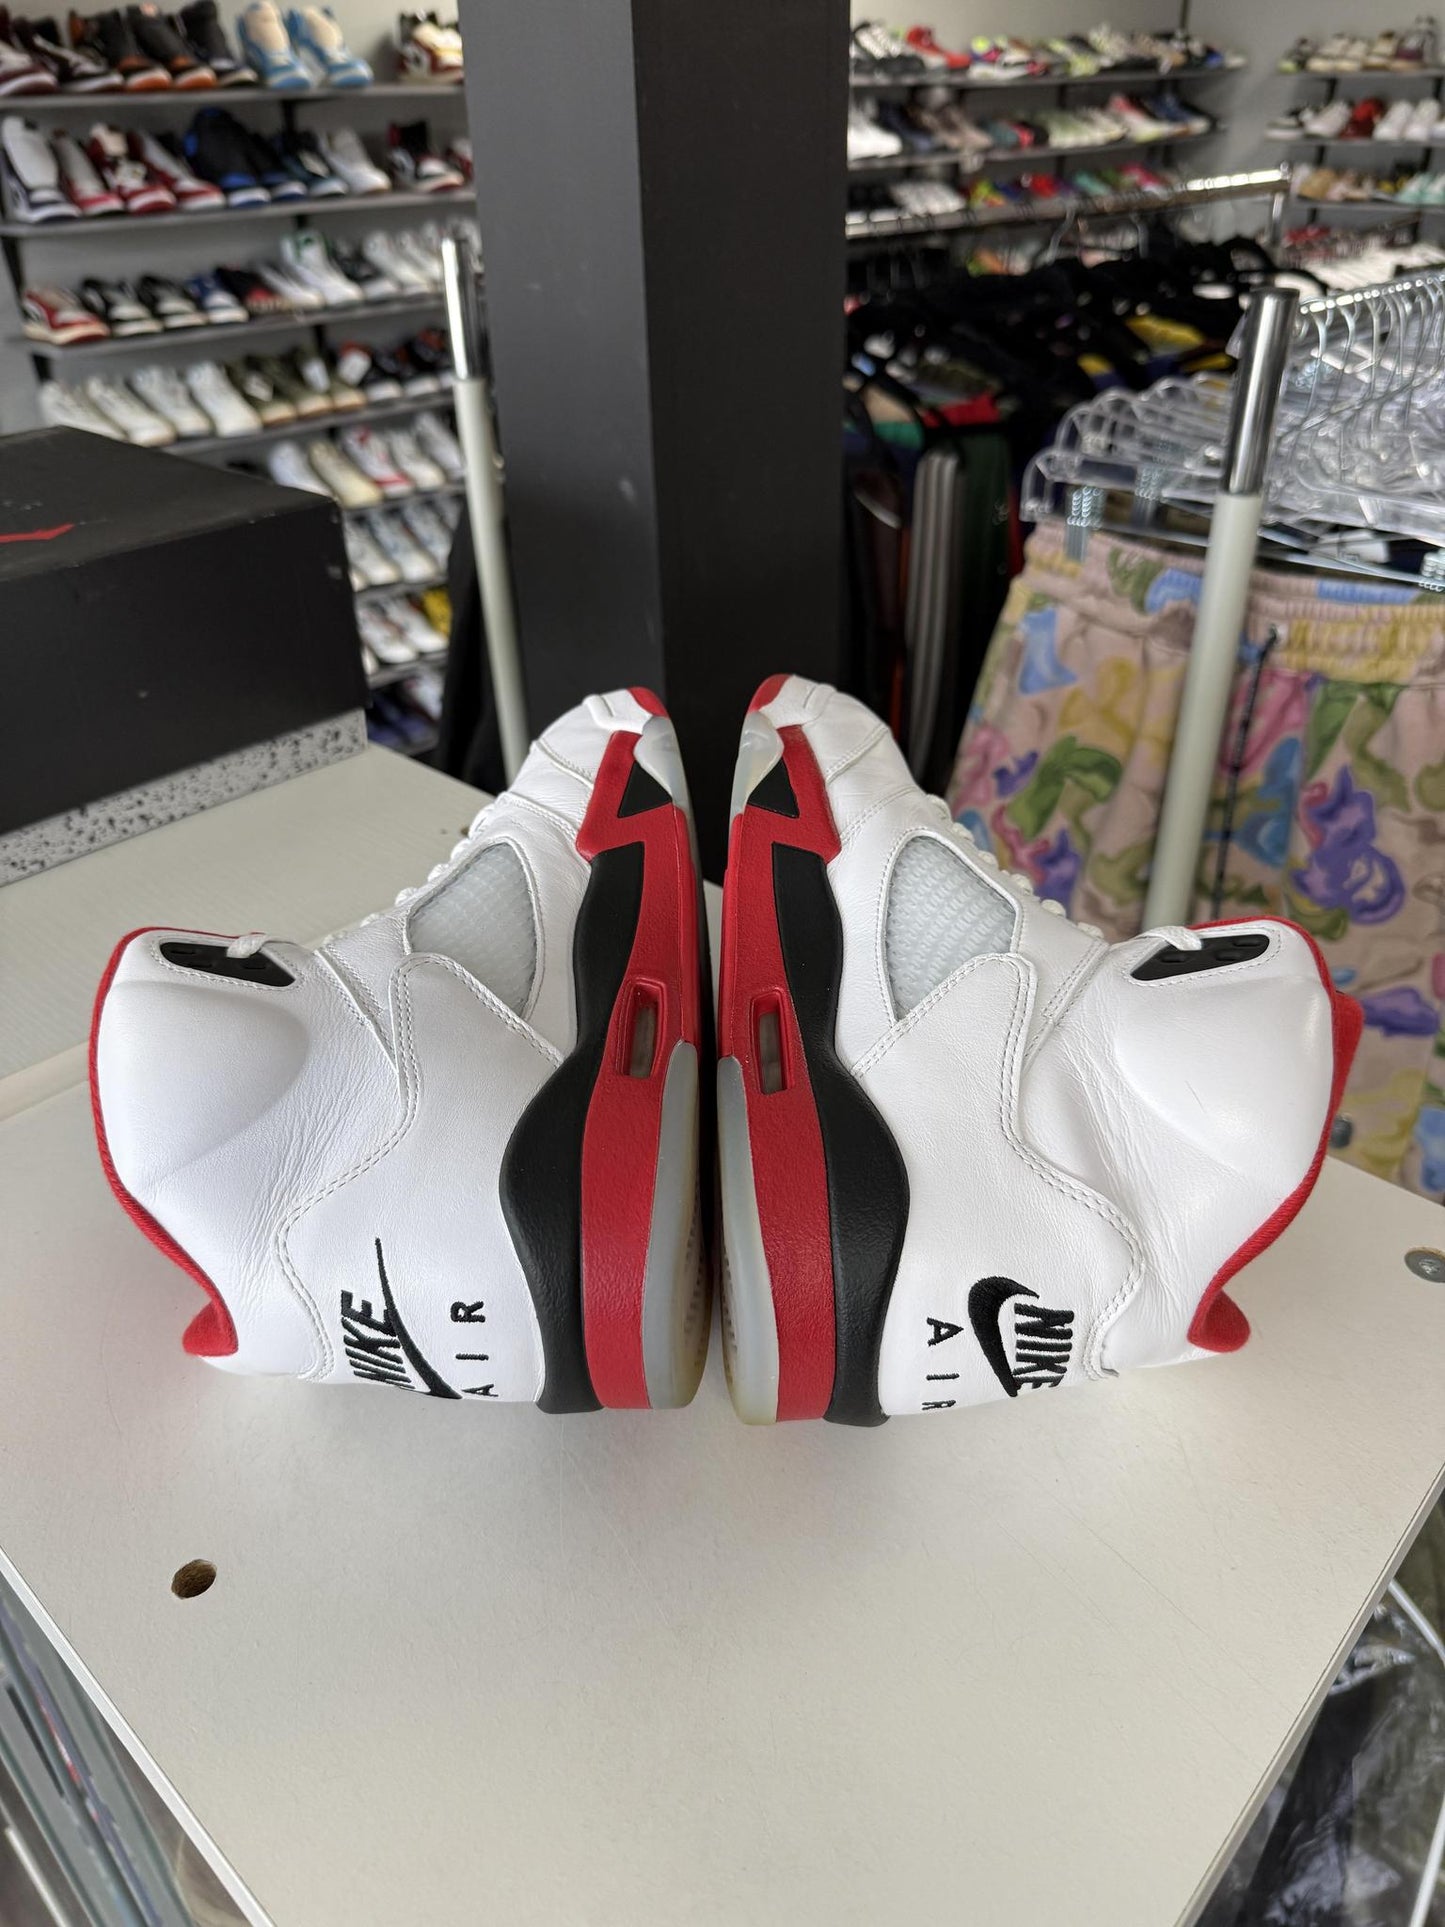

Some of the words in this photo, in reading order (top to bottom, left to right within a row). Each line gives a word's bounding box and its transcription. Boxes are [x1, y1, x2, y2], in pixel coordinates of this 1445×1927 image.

[341, 1290, 415, 1389] NIKE
[450, 1301, 499, 1397] AIR
[922, 1317, 964, 1411] AIR
[1012, 1303, 1074, 1389] NIKE
